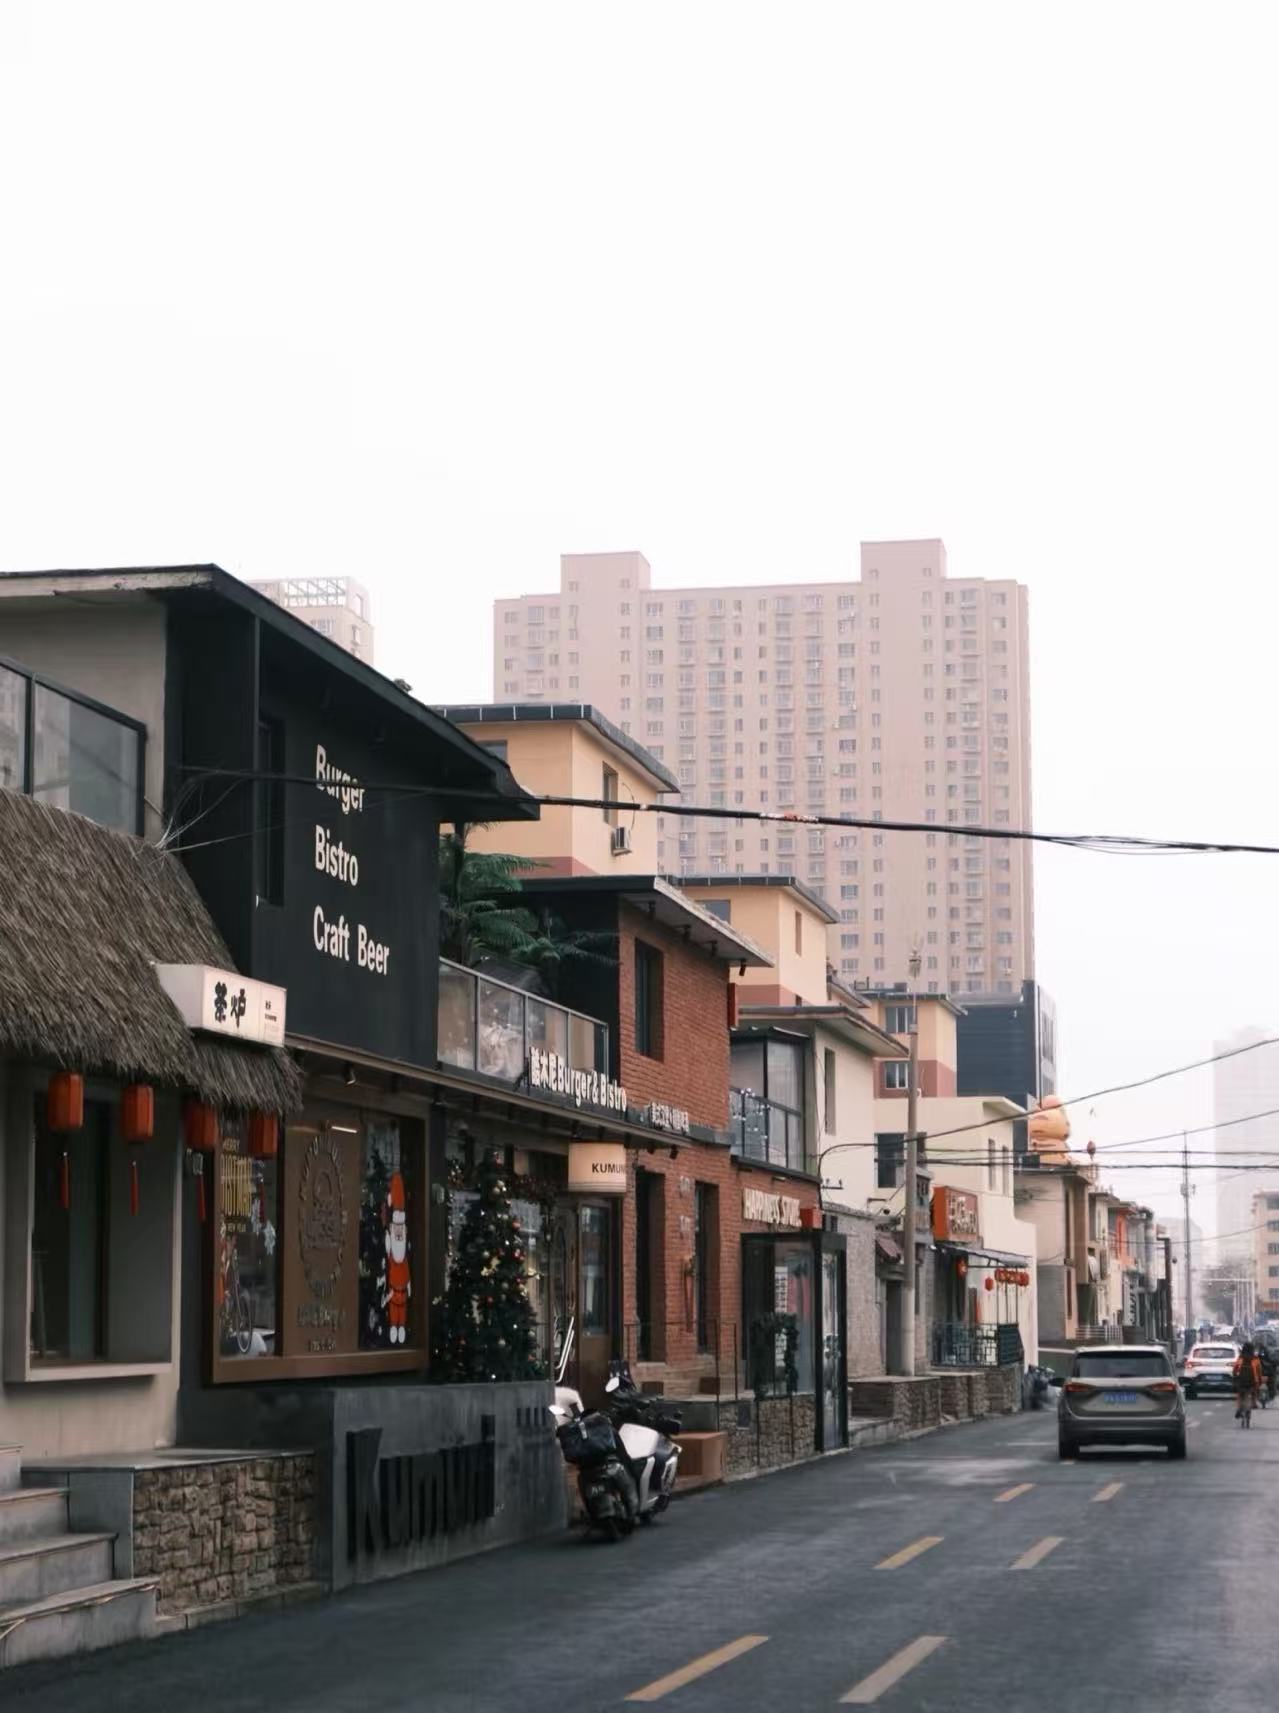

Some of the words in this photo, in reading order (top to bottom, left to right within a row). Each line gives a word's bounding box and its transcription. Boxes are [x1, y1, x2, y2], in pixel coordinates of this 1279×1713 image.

[316, 744, 365, 814] Burger
[315, 824, 359, 886] Bistro
[313, 904, 350, 961] Craft
[357, 923, 389, 975] Beer
[557, 1057, 592, 1107] Burger
[600, 1073, 627, 1112] Bistro
